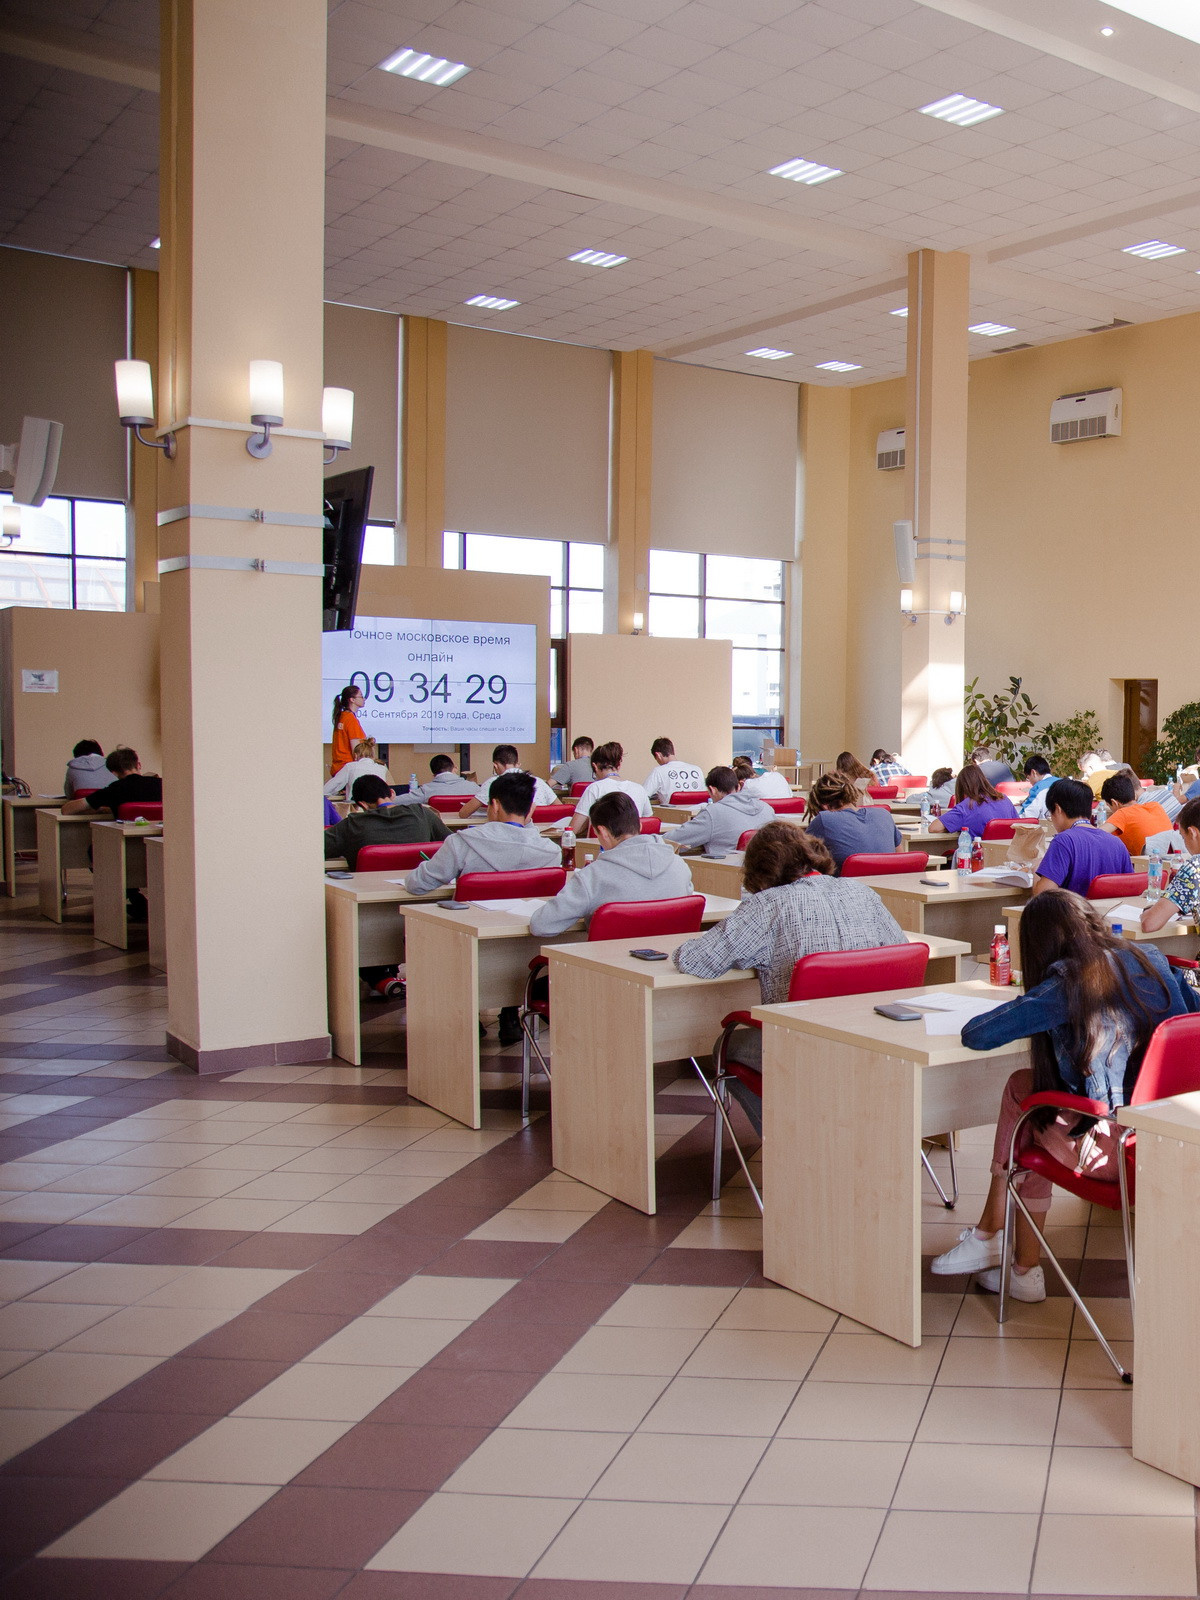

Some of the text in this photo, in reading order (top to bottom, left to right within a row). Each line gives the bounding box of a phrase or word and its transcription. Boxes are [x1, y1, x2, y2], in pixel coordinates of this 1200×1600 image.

[396, 631, 470, 644] московское
[473, 634, 511, 647] время
[407, 651, 454, 663] онлайн
[370, 710, 418, 721] Сентября
[420, 710, 444, 719] 2019
[472, 710, 502, 721] Среда
